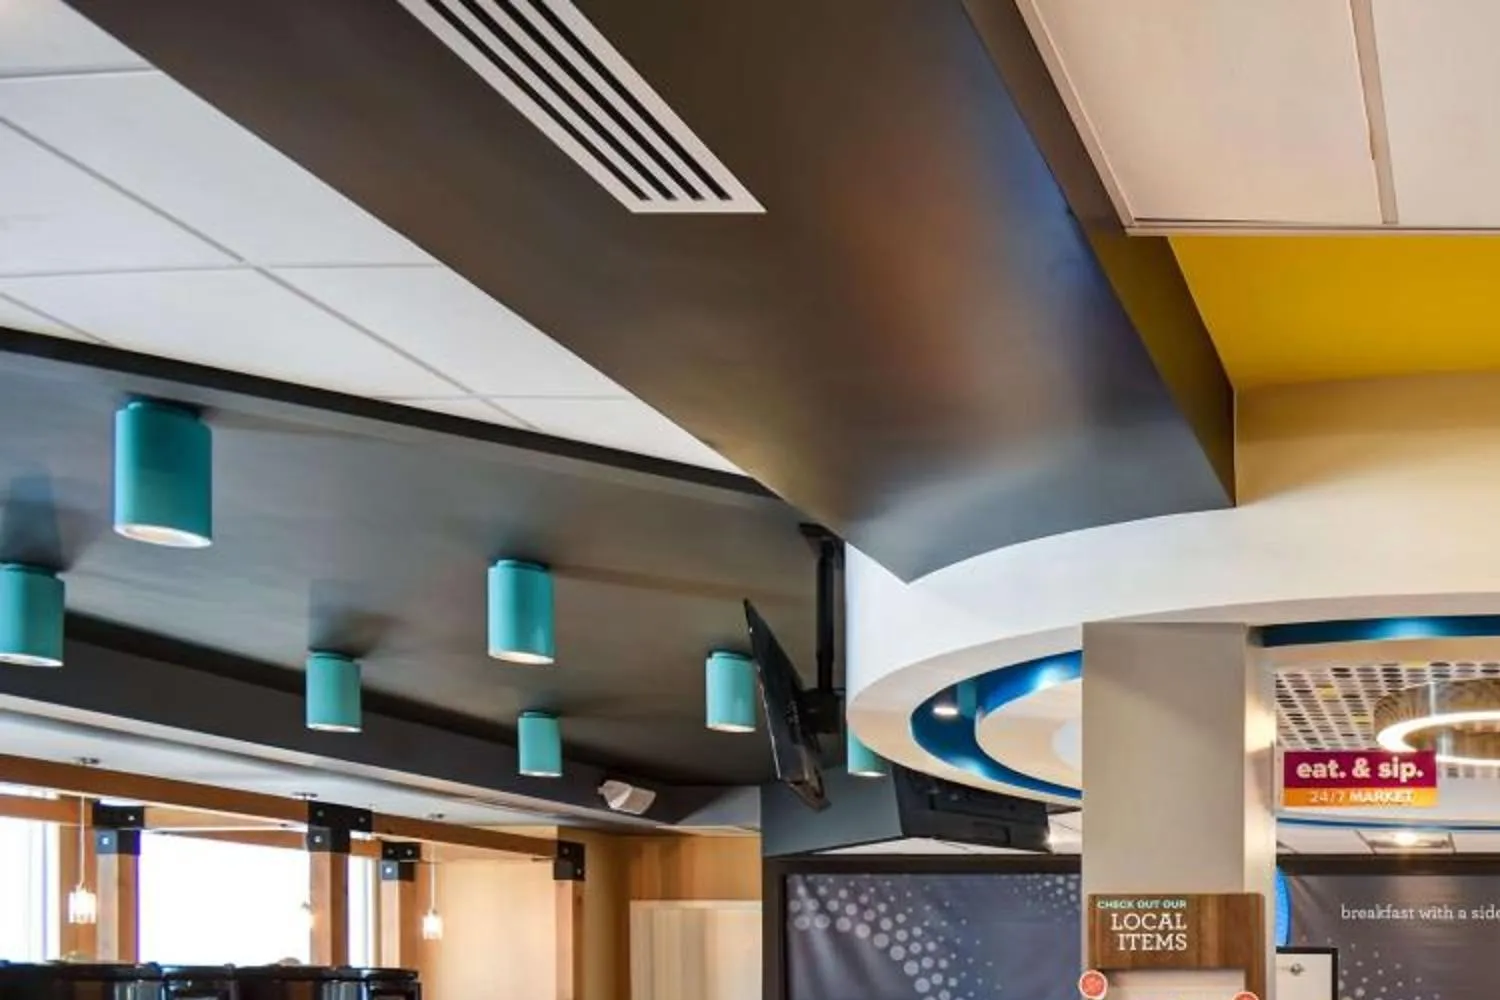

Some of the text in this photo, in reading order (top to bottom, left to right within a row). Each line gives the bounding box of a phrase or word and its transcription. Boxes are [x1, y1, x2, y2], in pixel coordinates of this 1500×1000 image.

[1296, 756, 1424, 783] eat. & sip.
[1310, 790, 1415, 803] 24/7 MARKET
[1097, 900, 1187, 909] CHECK OUT OUR
[1341, 903, 1416, 920] breakfast
[1418, 904, 1456, 920] with
[1458, 909, 1468, 920] a
[1111, 912, 1188, 931] LOCAL
[1118, 932, 1188, 951] ITEMS
